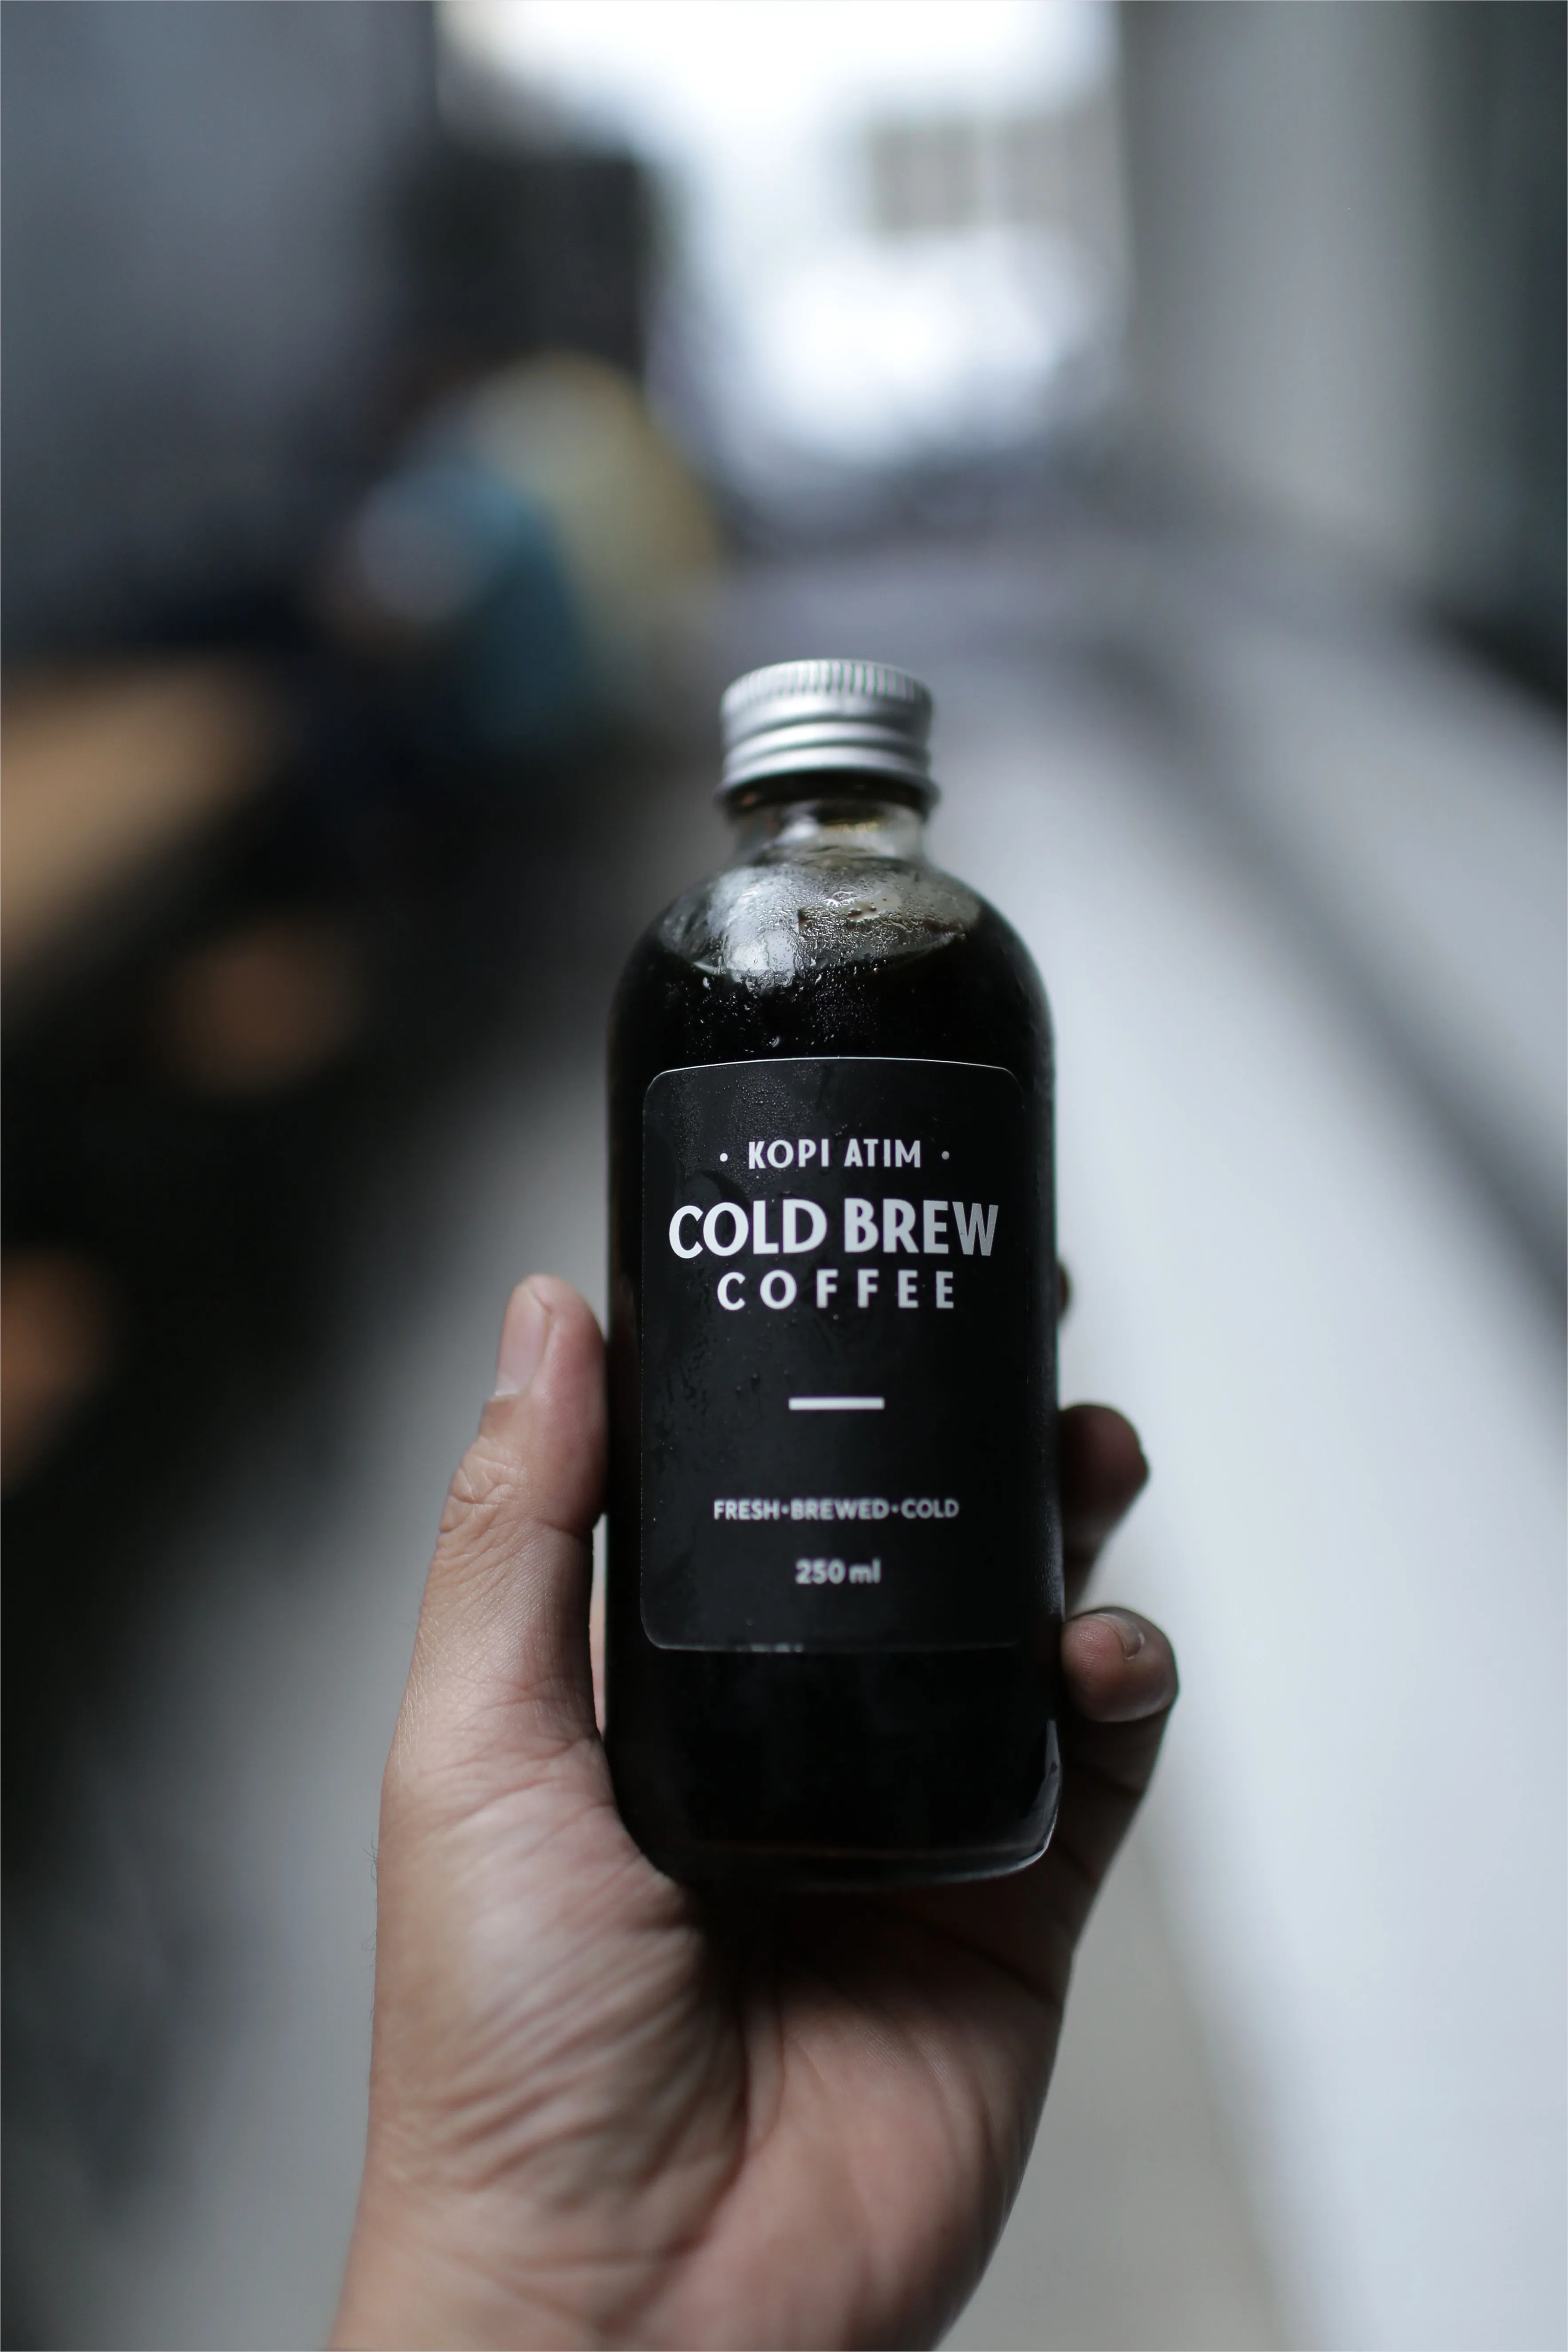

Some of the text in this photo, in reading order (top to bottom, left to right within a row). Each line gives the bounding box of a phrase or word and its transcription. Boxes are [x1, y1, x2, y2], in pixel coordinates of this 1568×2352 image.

[748, 1138, 921, 1170] KOPI ATIM
[668, 1198, 999, 1259] COLD BREW
[717, 1269, 954, 1311] COFFEE
[795, 1559, 881, 1584] 250 ml
